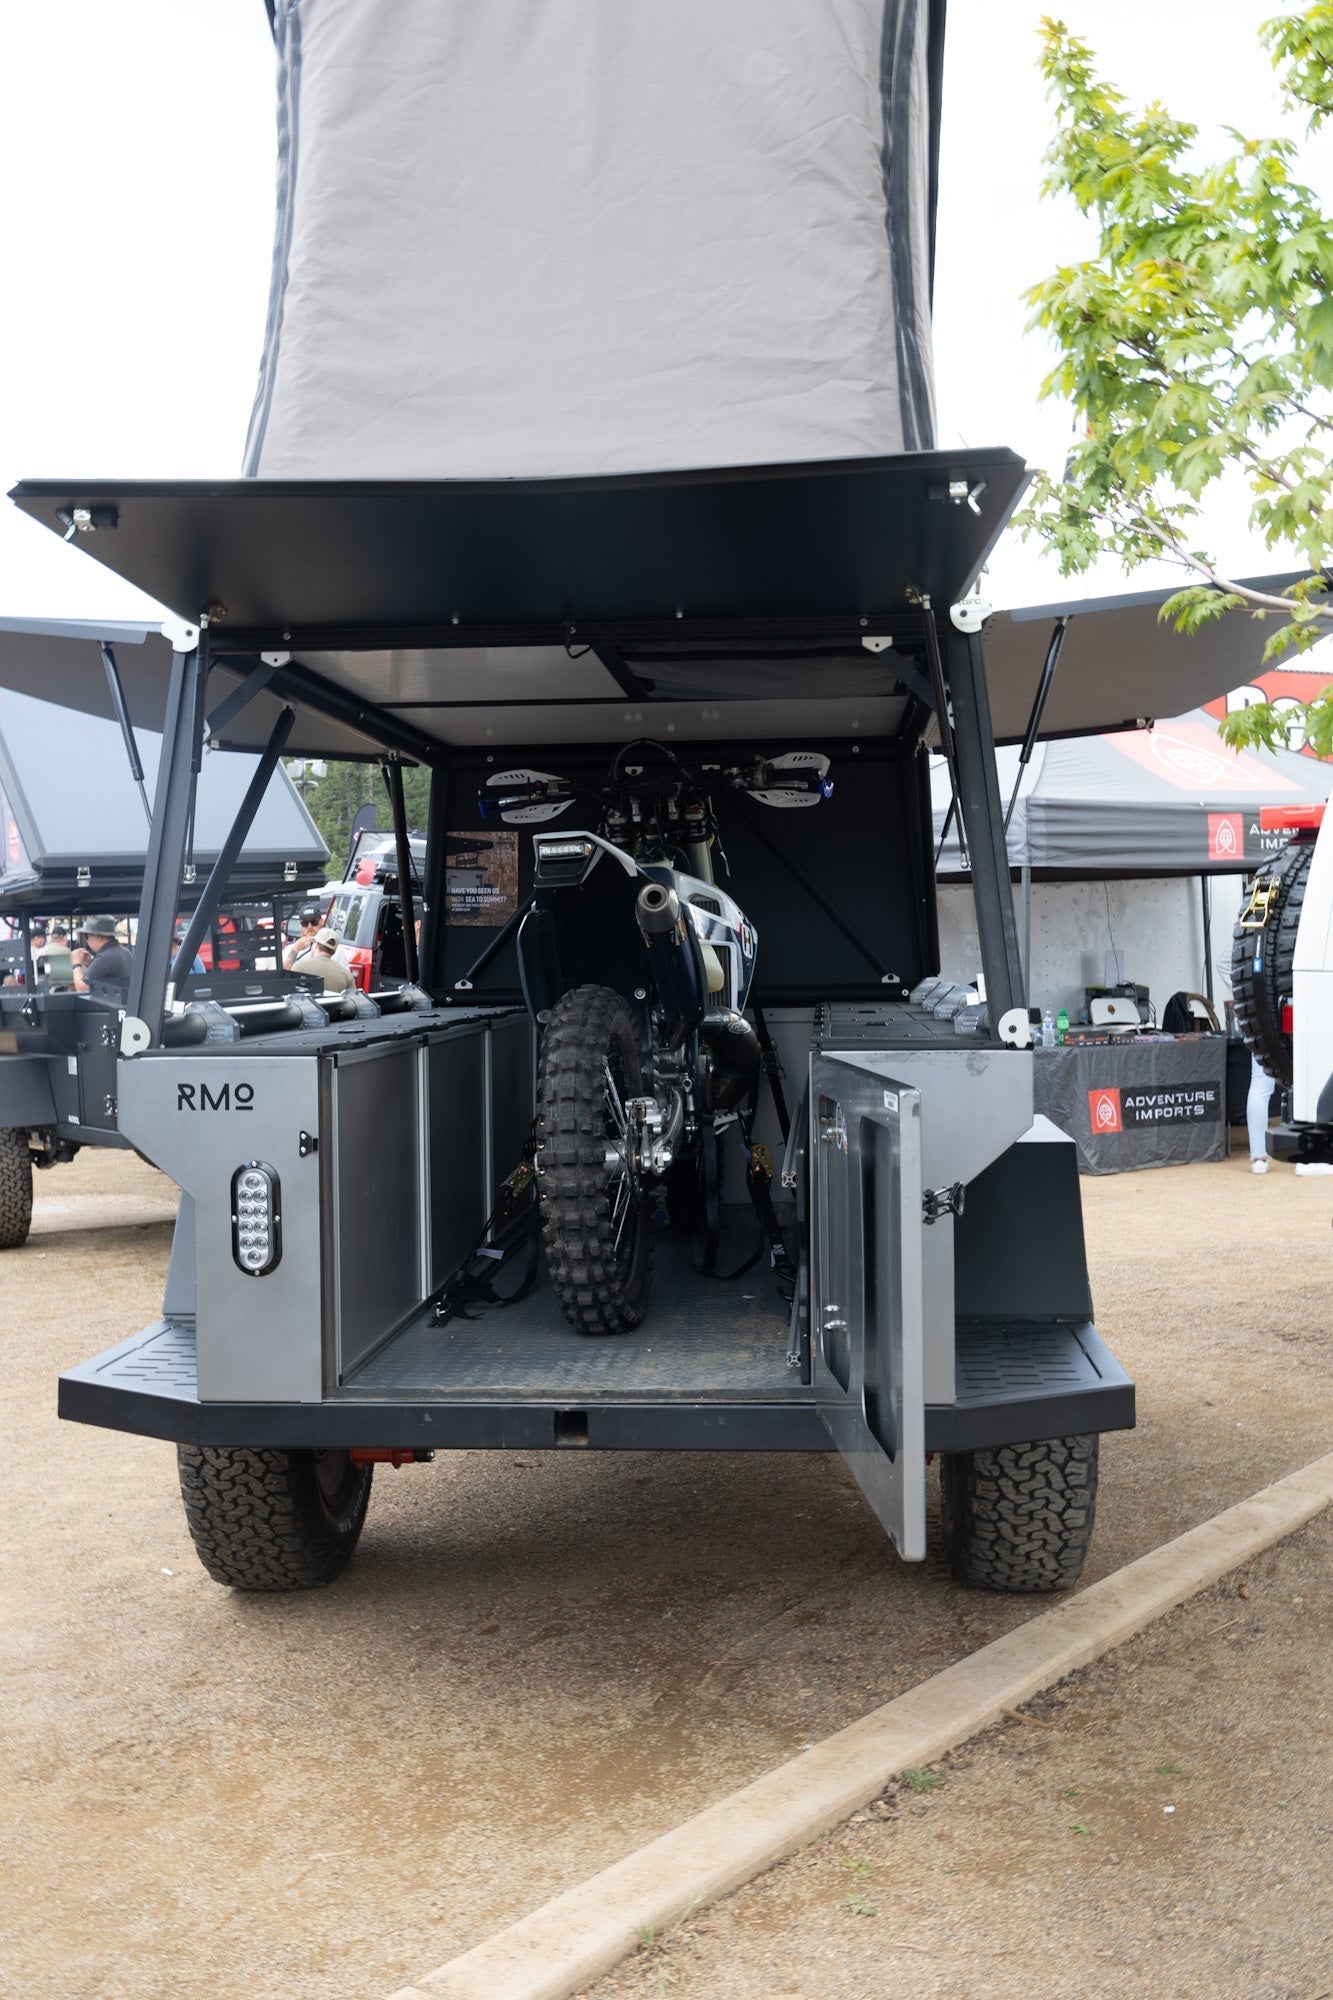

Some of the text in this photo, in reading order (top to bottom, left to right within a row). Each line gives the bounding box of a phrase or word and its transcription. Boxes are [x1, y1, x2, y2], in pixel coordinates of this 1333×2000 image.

[177, 1083, 254, 1111] RMO
[1125, 1090, 1215, 1108] ADVENTURE
[1135, 1104, 1205, 1120] IMPORTS
